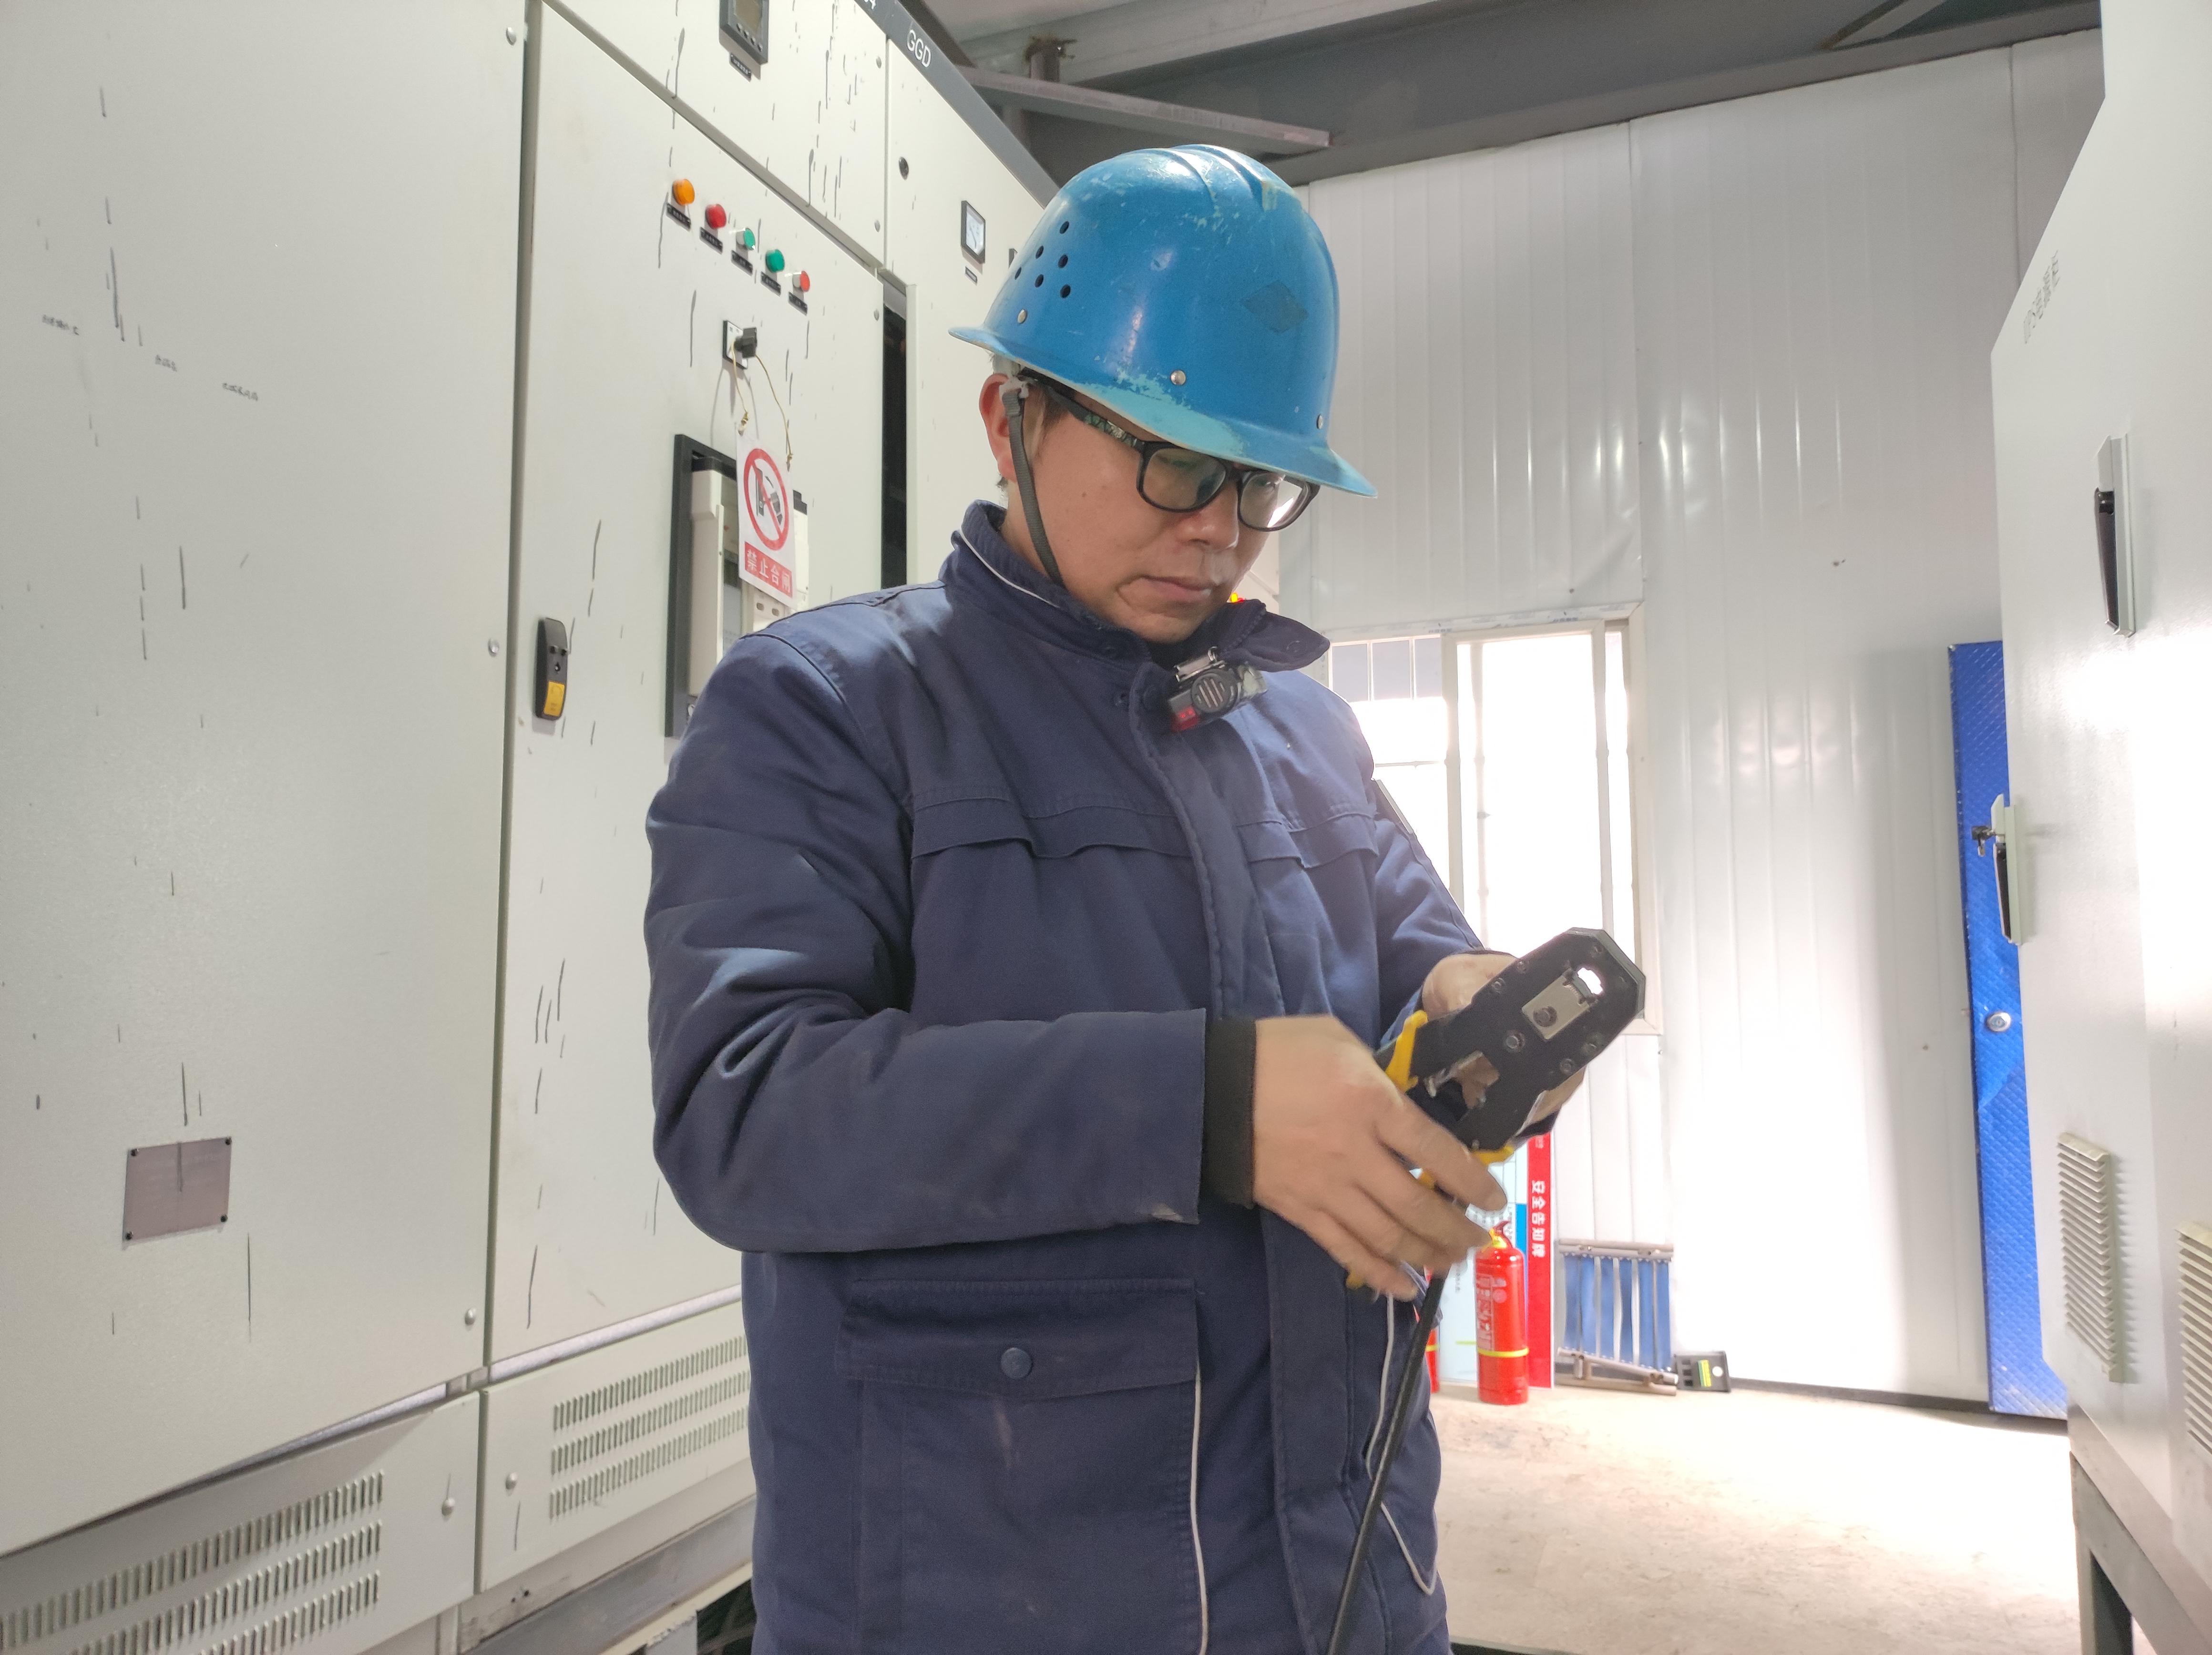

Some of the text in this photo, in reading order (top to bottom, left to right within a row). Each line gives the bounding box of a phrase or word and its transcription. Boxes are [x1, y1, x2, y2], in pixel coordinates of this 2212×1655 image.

[907, 30, 932, 68] GGD
[747, 549, 791, 593] 禁止合闸
[1532, 1180, 1546, 1257] 安全告知牌
